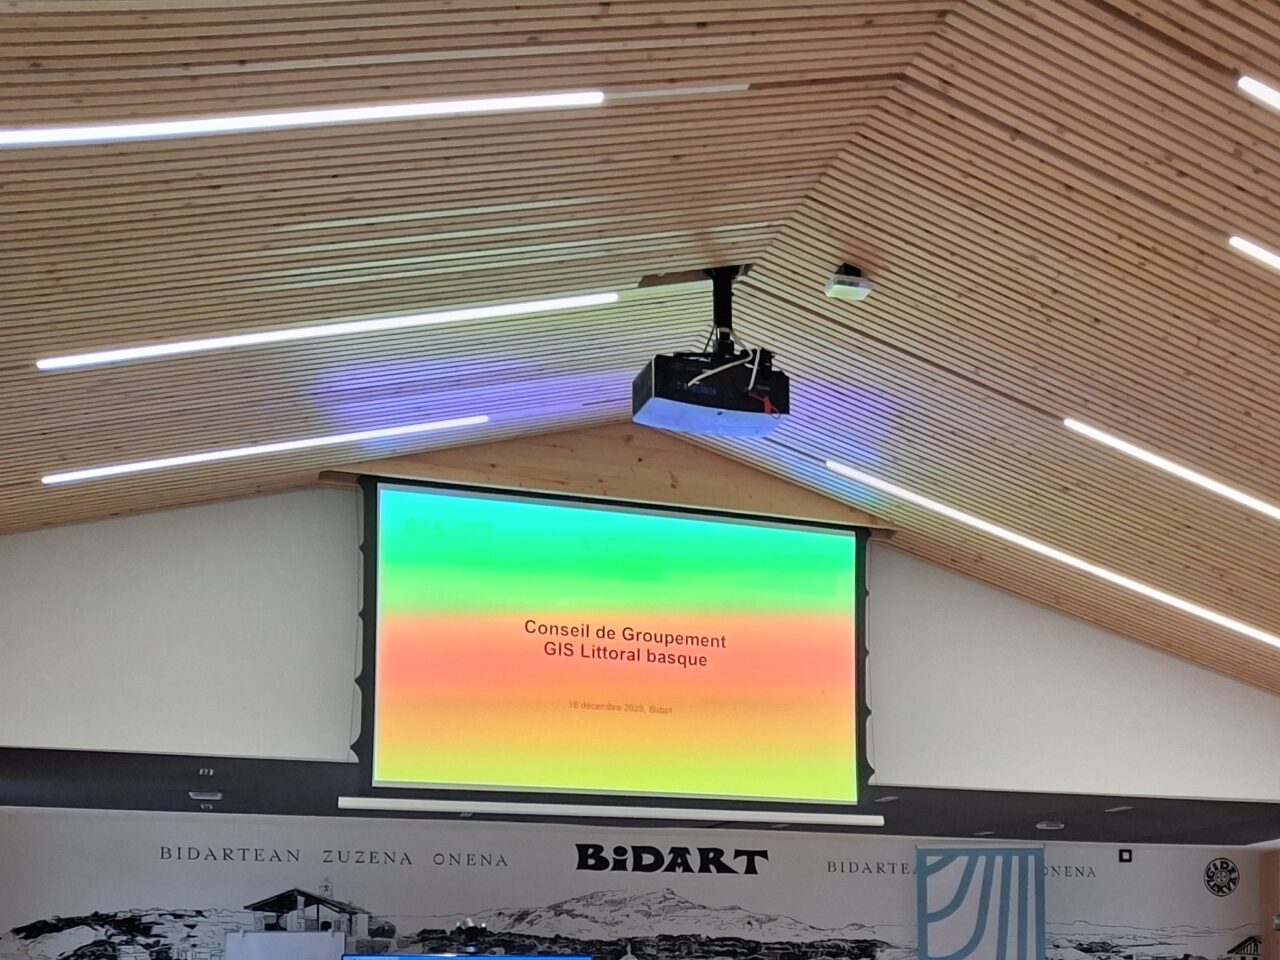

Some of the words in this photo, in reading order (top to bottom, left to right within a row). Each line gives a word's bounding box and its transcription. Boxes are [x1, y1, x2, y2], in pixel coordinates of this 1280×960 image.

[524, 619, 589, 638] Conseil
[595, 625, 616, 640] de
[622, 627, 727, 649] Groupement
[544, 641, 574, 657] GIS
[581, 643, 640, 662] Littoral
[647, 648, 708, 668] basque
[159, 846, 301, 863] BIDARTEAN
[322, 850, 413, 865] ZUZENA
[432, 852, 508, 867] ONENA
[827, 861, 917, 875] BIDARTE
